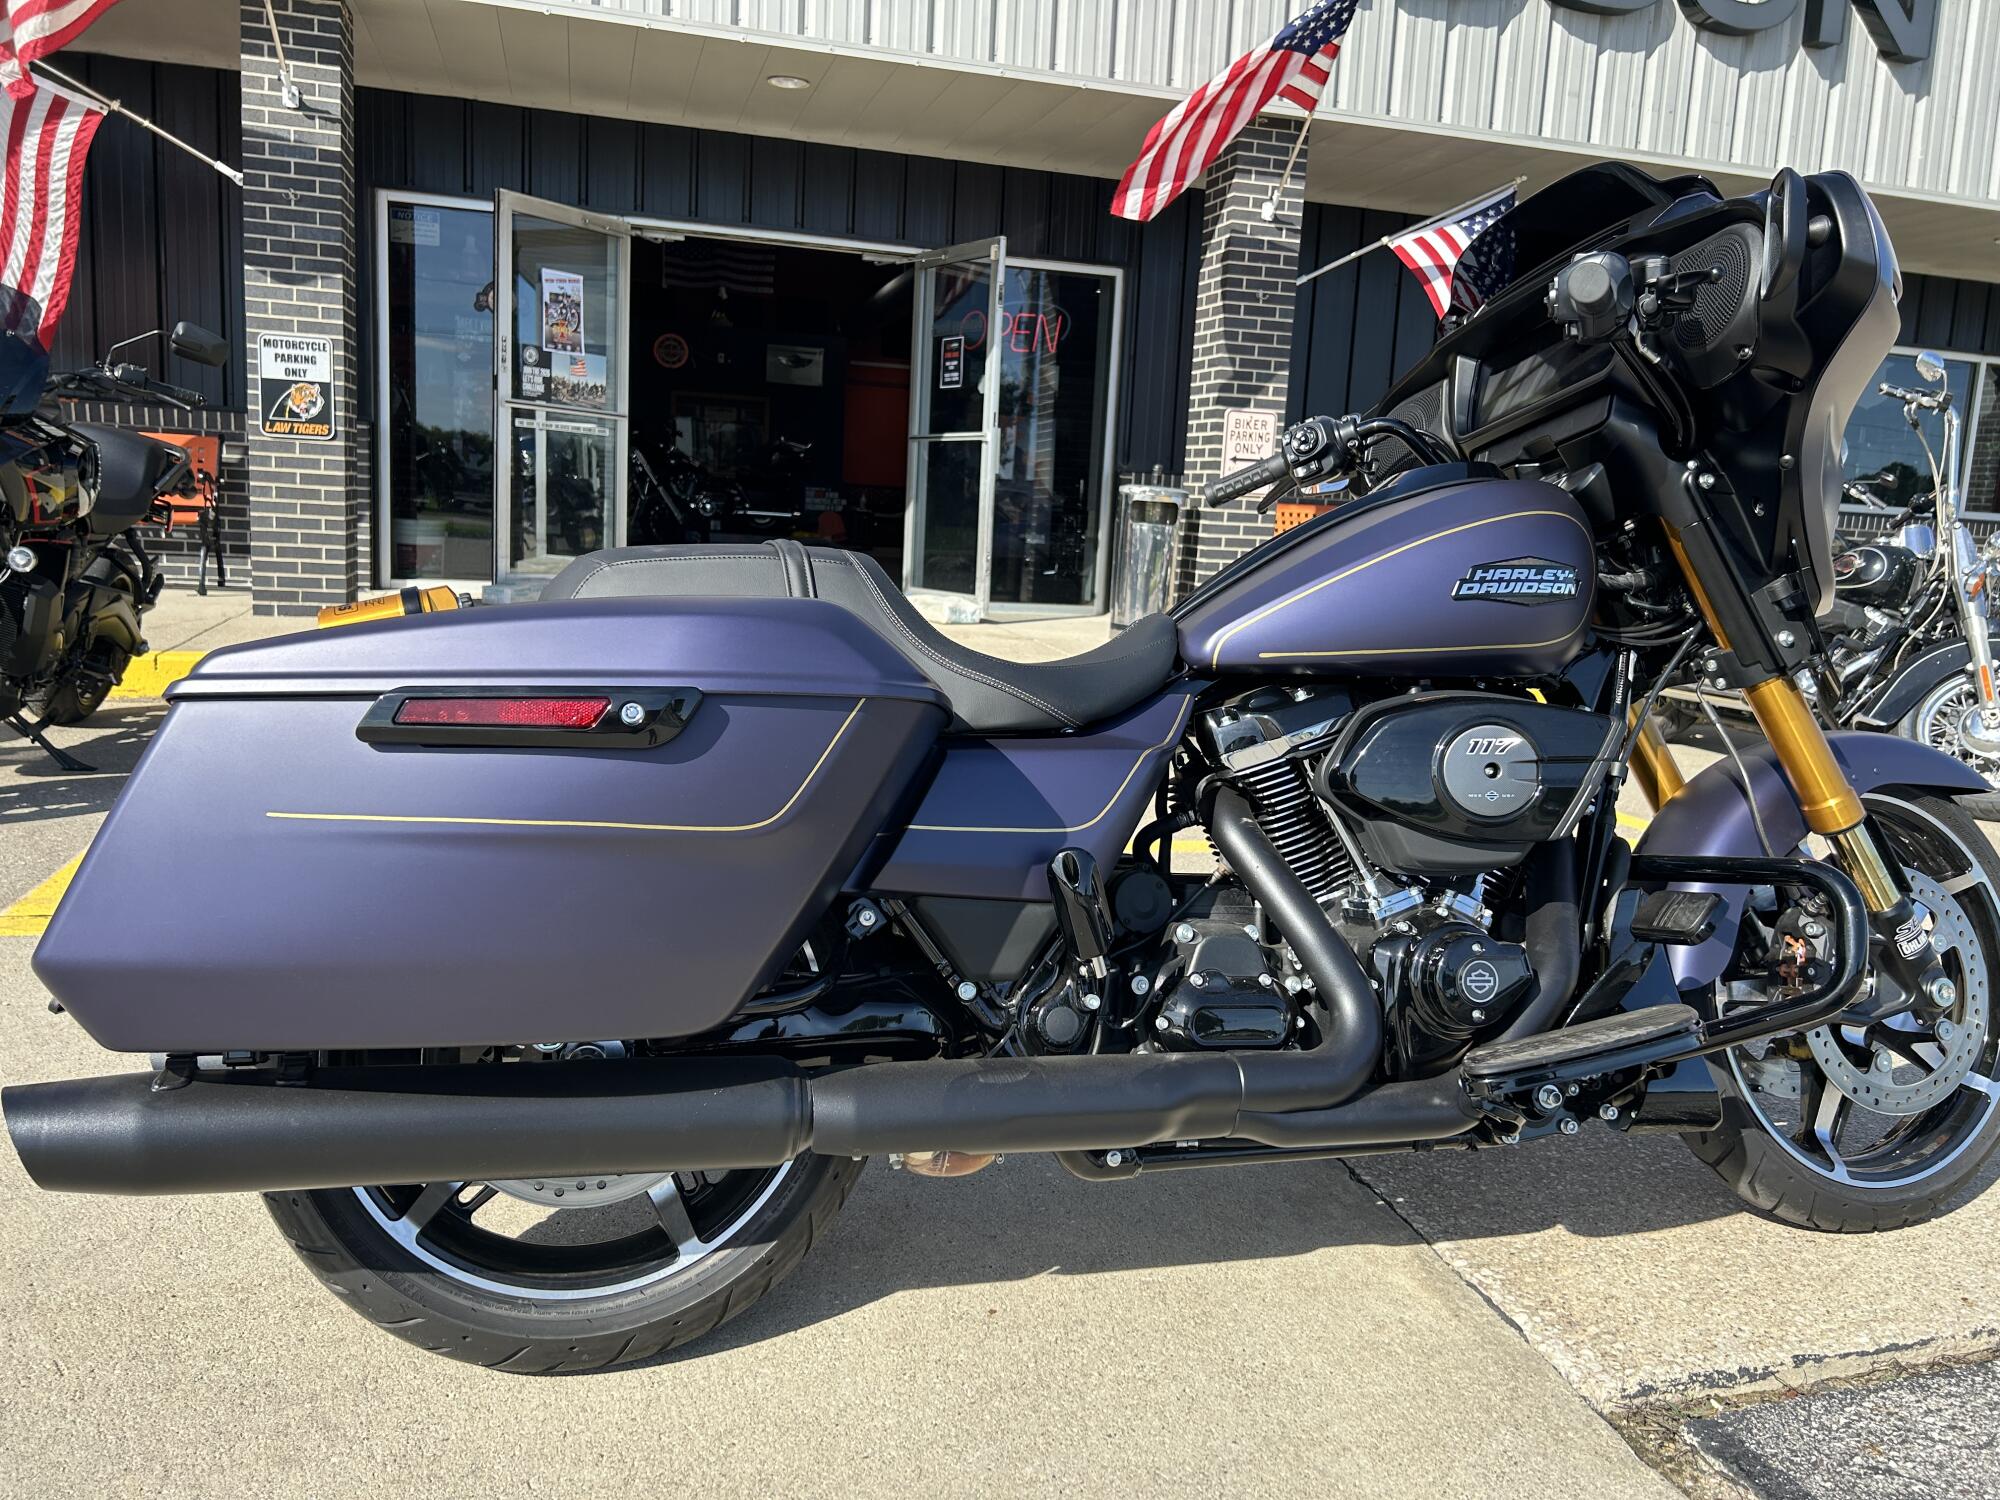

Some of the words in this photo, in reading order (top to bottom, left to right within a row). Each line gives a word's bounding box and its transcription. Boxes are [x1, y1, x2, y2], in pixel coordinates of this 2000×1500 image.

[959, 309, 1063, 353] OPEN
[263, 338, 328, 353] MOTORCYCLE
[274, 353, 317, 365] PARKING
[284, 367, 308, 378] ONLY
[264, 421, 291, 434] LAW
[293, 422, 330, 435] TIGERS
[1234, 418, 1268, 431] BIKER
[1230, 430, 1270, 443] PARKING
[1234, 443, 1264, 455] ONLY
[1458, 582, 1577, 595] DAVIDSON
[1466, 737, 1523, 755] 117
